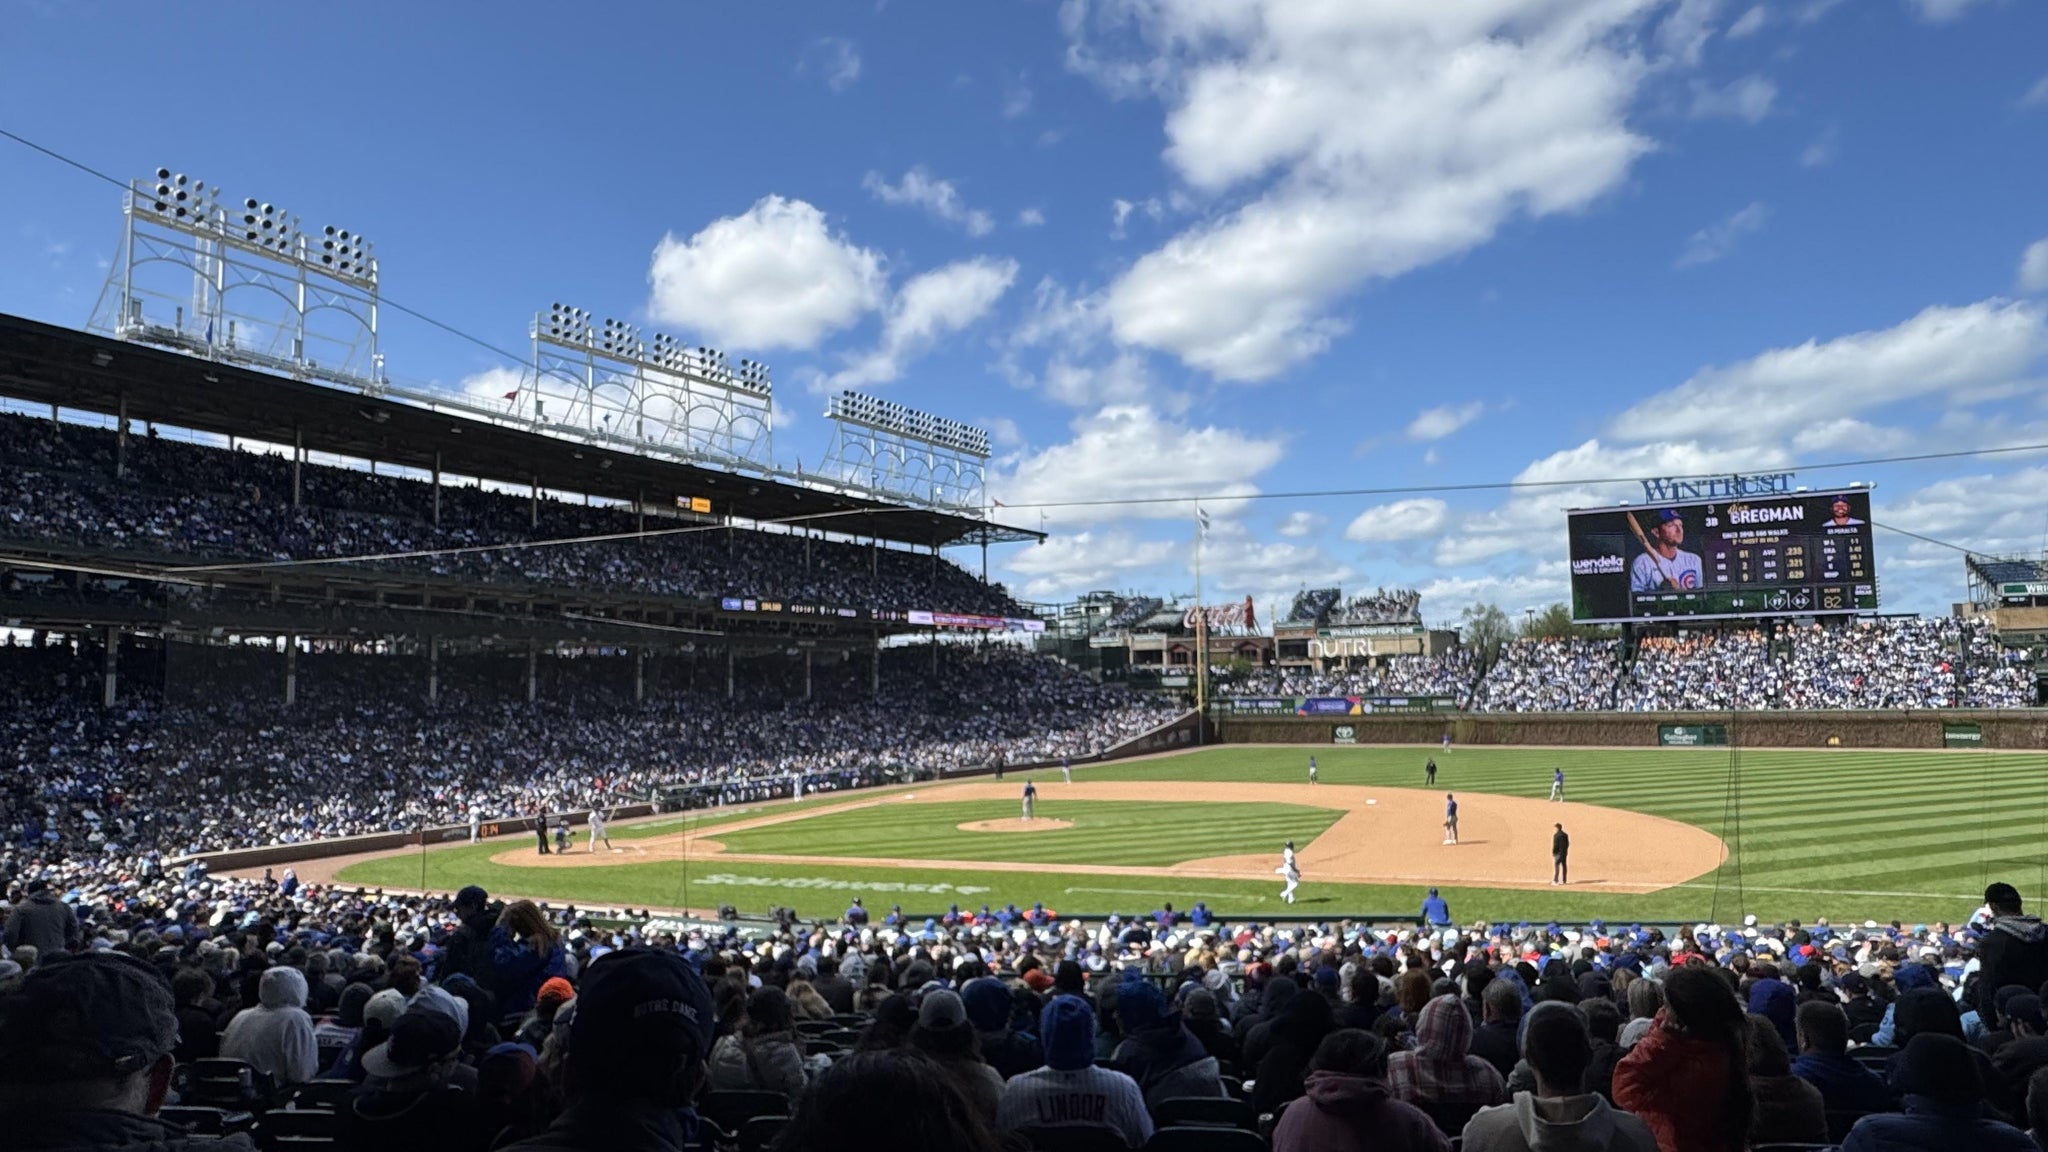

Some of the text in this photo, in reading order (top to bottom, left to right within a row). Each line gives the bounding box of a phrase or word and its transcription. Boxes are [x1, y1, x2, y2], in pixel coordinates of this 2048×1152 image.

[1641, 473, 1795, 501] WINTRUST
[1730, 505, 1804, 525] BREGMAN
[1572, 555, 1625, 569] wendella
[2025, 584, 2048, 594] WRI
[1823, 596, 1842, 609] 82
[633, 999, 699, 1024] NOTRE DAME
[1037, 1093, 1106, 1123] LINDOR
